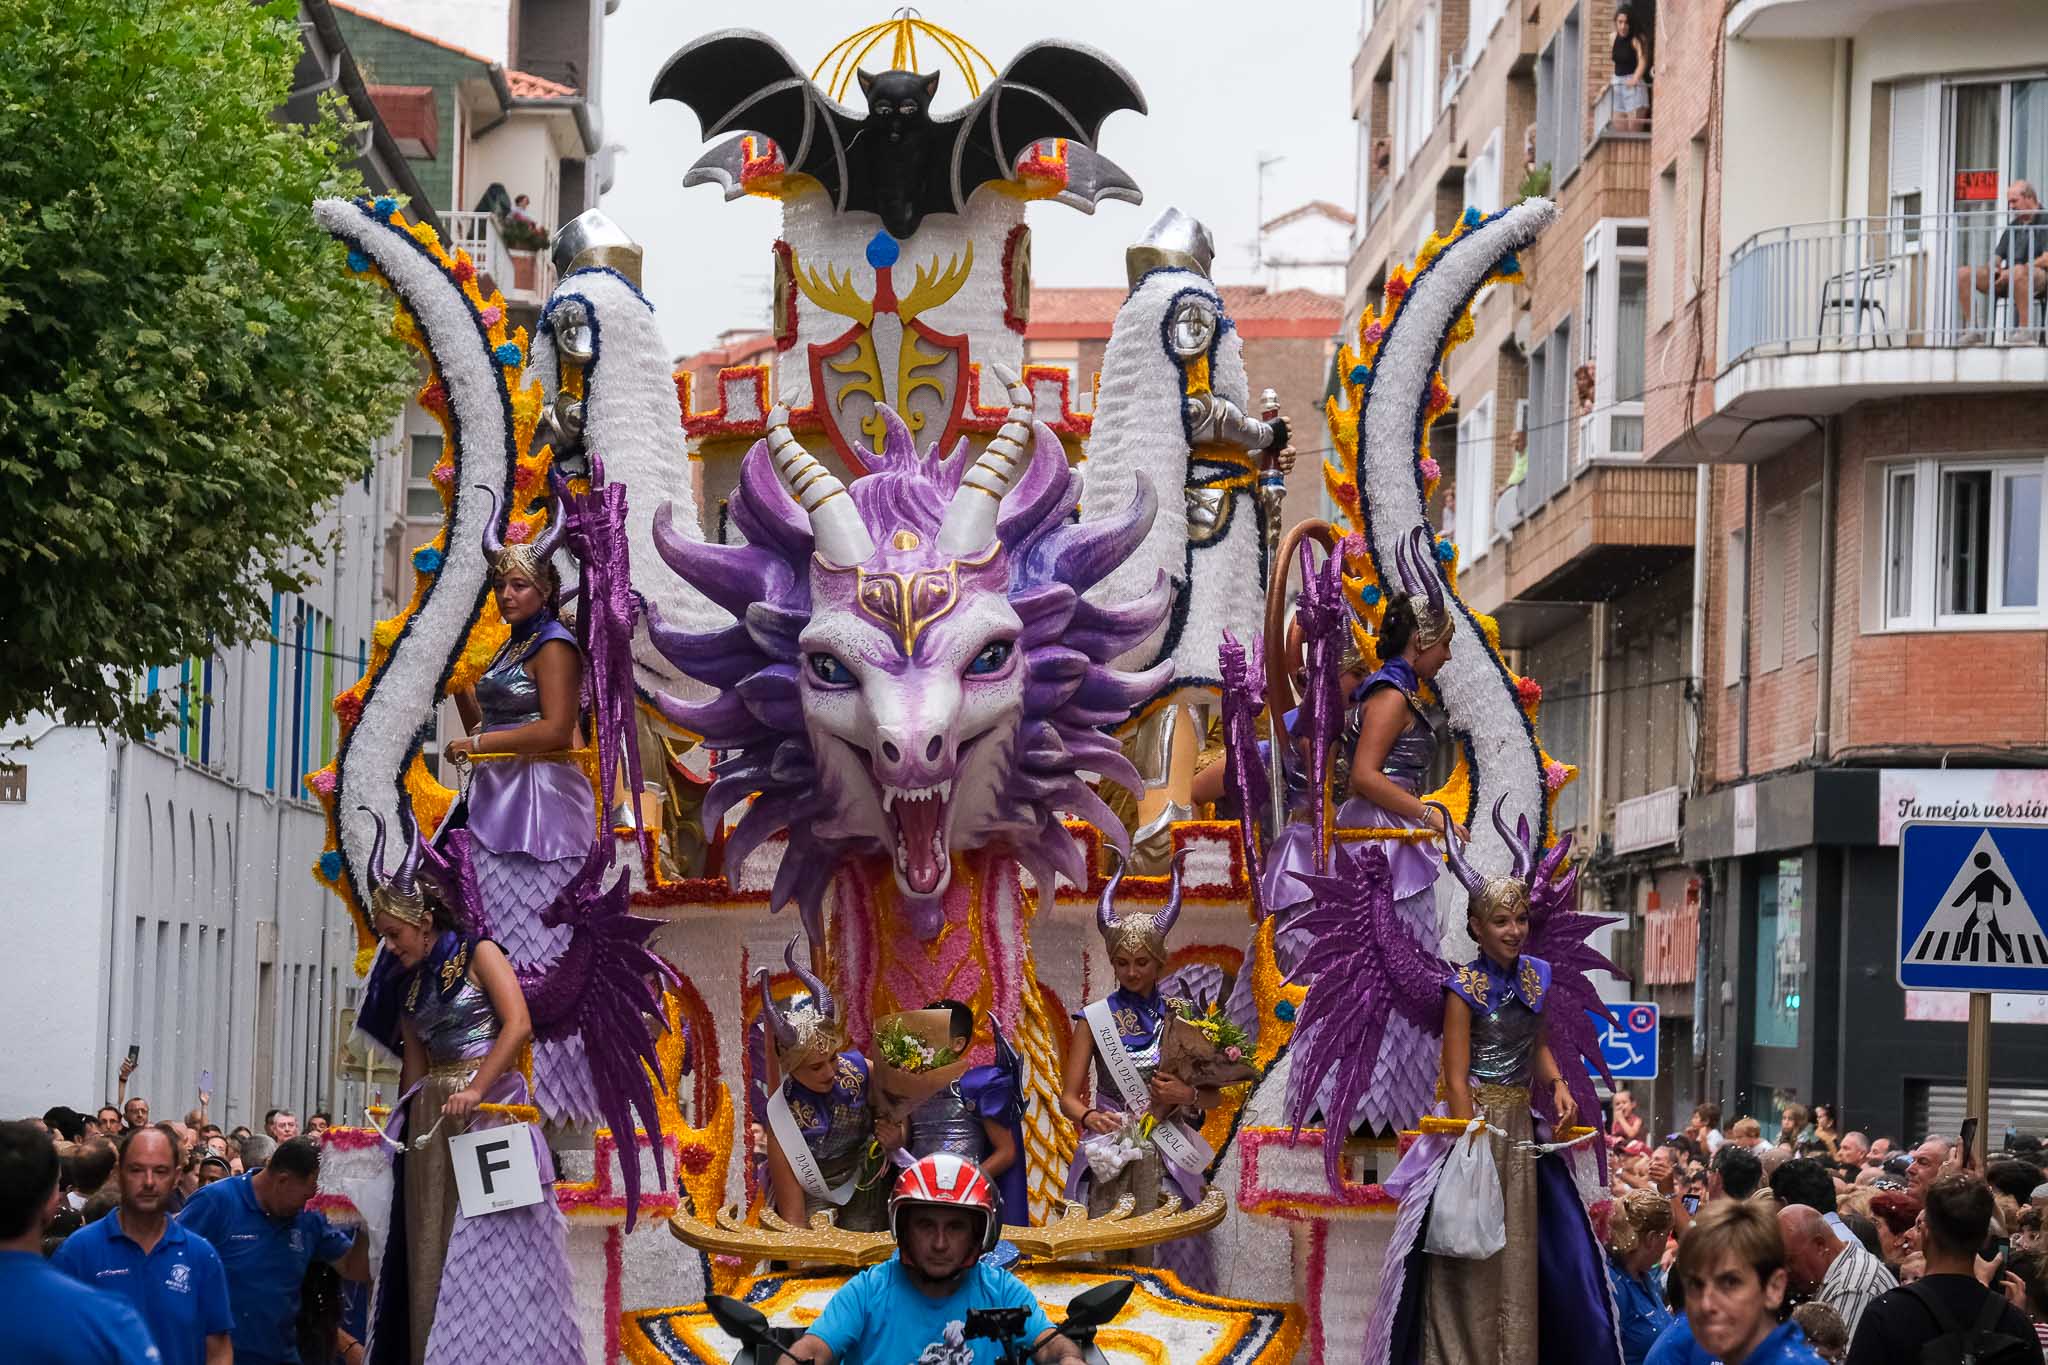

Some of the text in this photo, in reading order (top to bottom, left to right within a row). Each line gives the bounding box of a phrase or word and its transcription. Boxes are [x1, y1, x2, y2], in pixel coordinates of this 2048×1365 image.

[1898, 798, 1923, 818] Tu
[1926, 800, 1980, 820] mejor
[1100, 1026, 1184, 1152] REINA DE GAL ORAL
[475, 1140, 510, 1194] F
[795, 1154, 817, 1185] DAMA
